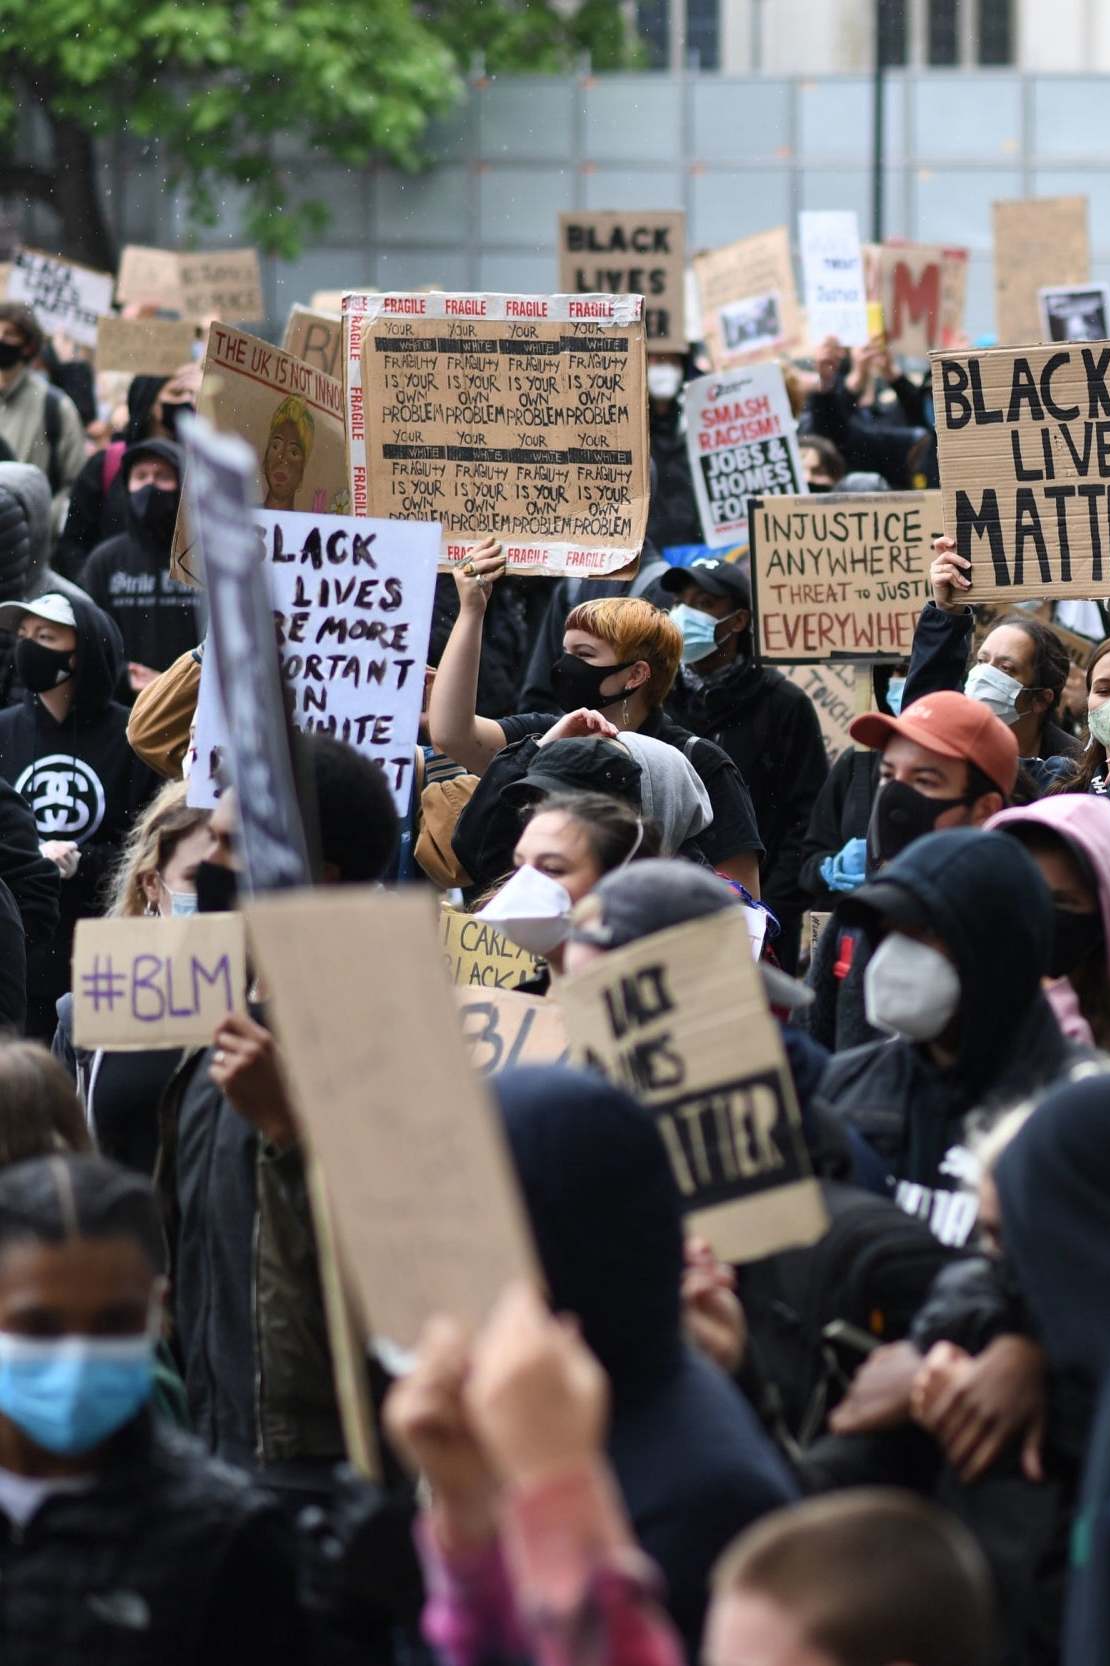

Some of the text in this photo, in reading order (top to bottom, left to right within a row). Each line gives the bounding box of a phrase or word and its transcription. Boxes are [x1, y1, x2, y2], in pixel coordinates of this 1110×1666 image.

[566, 224, 671, 254] BLACK
[575, 268, 665, 294] LIVES
[384, 298, 426, 314] FRAGILE
[445, 299, 487, 316] FRAGILE
[506, 301, 548, 318] FRAGILE
[569, 301, 614, 318] FRAGILE
[350, 315, 362, 360] RAGILE
[384, 322, 413, 336] YOUR
[450, 323, 477, 337] YOUR
[508, 324, 538, 338] YOUR
[216, 331, 248, 364] THE
[251, 349, 273, 377] UK
[275, 356, 288, 384] IS
[290, 362, 313, 396] NOT
[385, 374, 625, 394] IS YOUR IS YOUR IS YOUR IS YOUR
[396, 391, 611, 406] OWN OWN OWN OWN
[350, 387, 364, 440] FRAGILE
[382, 404, 629, 427] PROBLEM PROBLEM PROBLEM PROBLEM
[701, 395, 770, 428] SMASH
[393, 430, 609, 447] YOUR YOUR YOUR YOUR
[698, 415, 782, 451] RACISM!
[708, 438, 788, 477] JOBS &
[392, 481, 632, 504] IS YOUR IS YOUR IS YOUR IS YOUR
[711, 462, 792, 500] HOMES
[402, 497, 619, 517] OWN OWN OWN OWN
[451, 513, 511, 532] PROBLEM
[512, 516, 572, 535] PROBLEM
[573, 517, 632, 537] PROBLEM
[764, 510, 923, 543] INJUSTICE
[508, 548, 606, 568] FRAGILE FRAGILE
[766, 544, 924, 578] ANYWHERE
[292, 576, 403, 611] LIVES
[769, 582, 852, 605] THREAT
[855, 588, 871, 600] TO
[273, 610, 411, 653] RE MORE
[280, 653, 416, 690] ORTANT
[81, 953, 234, 1022] #BLM
